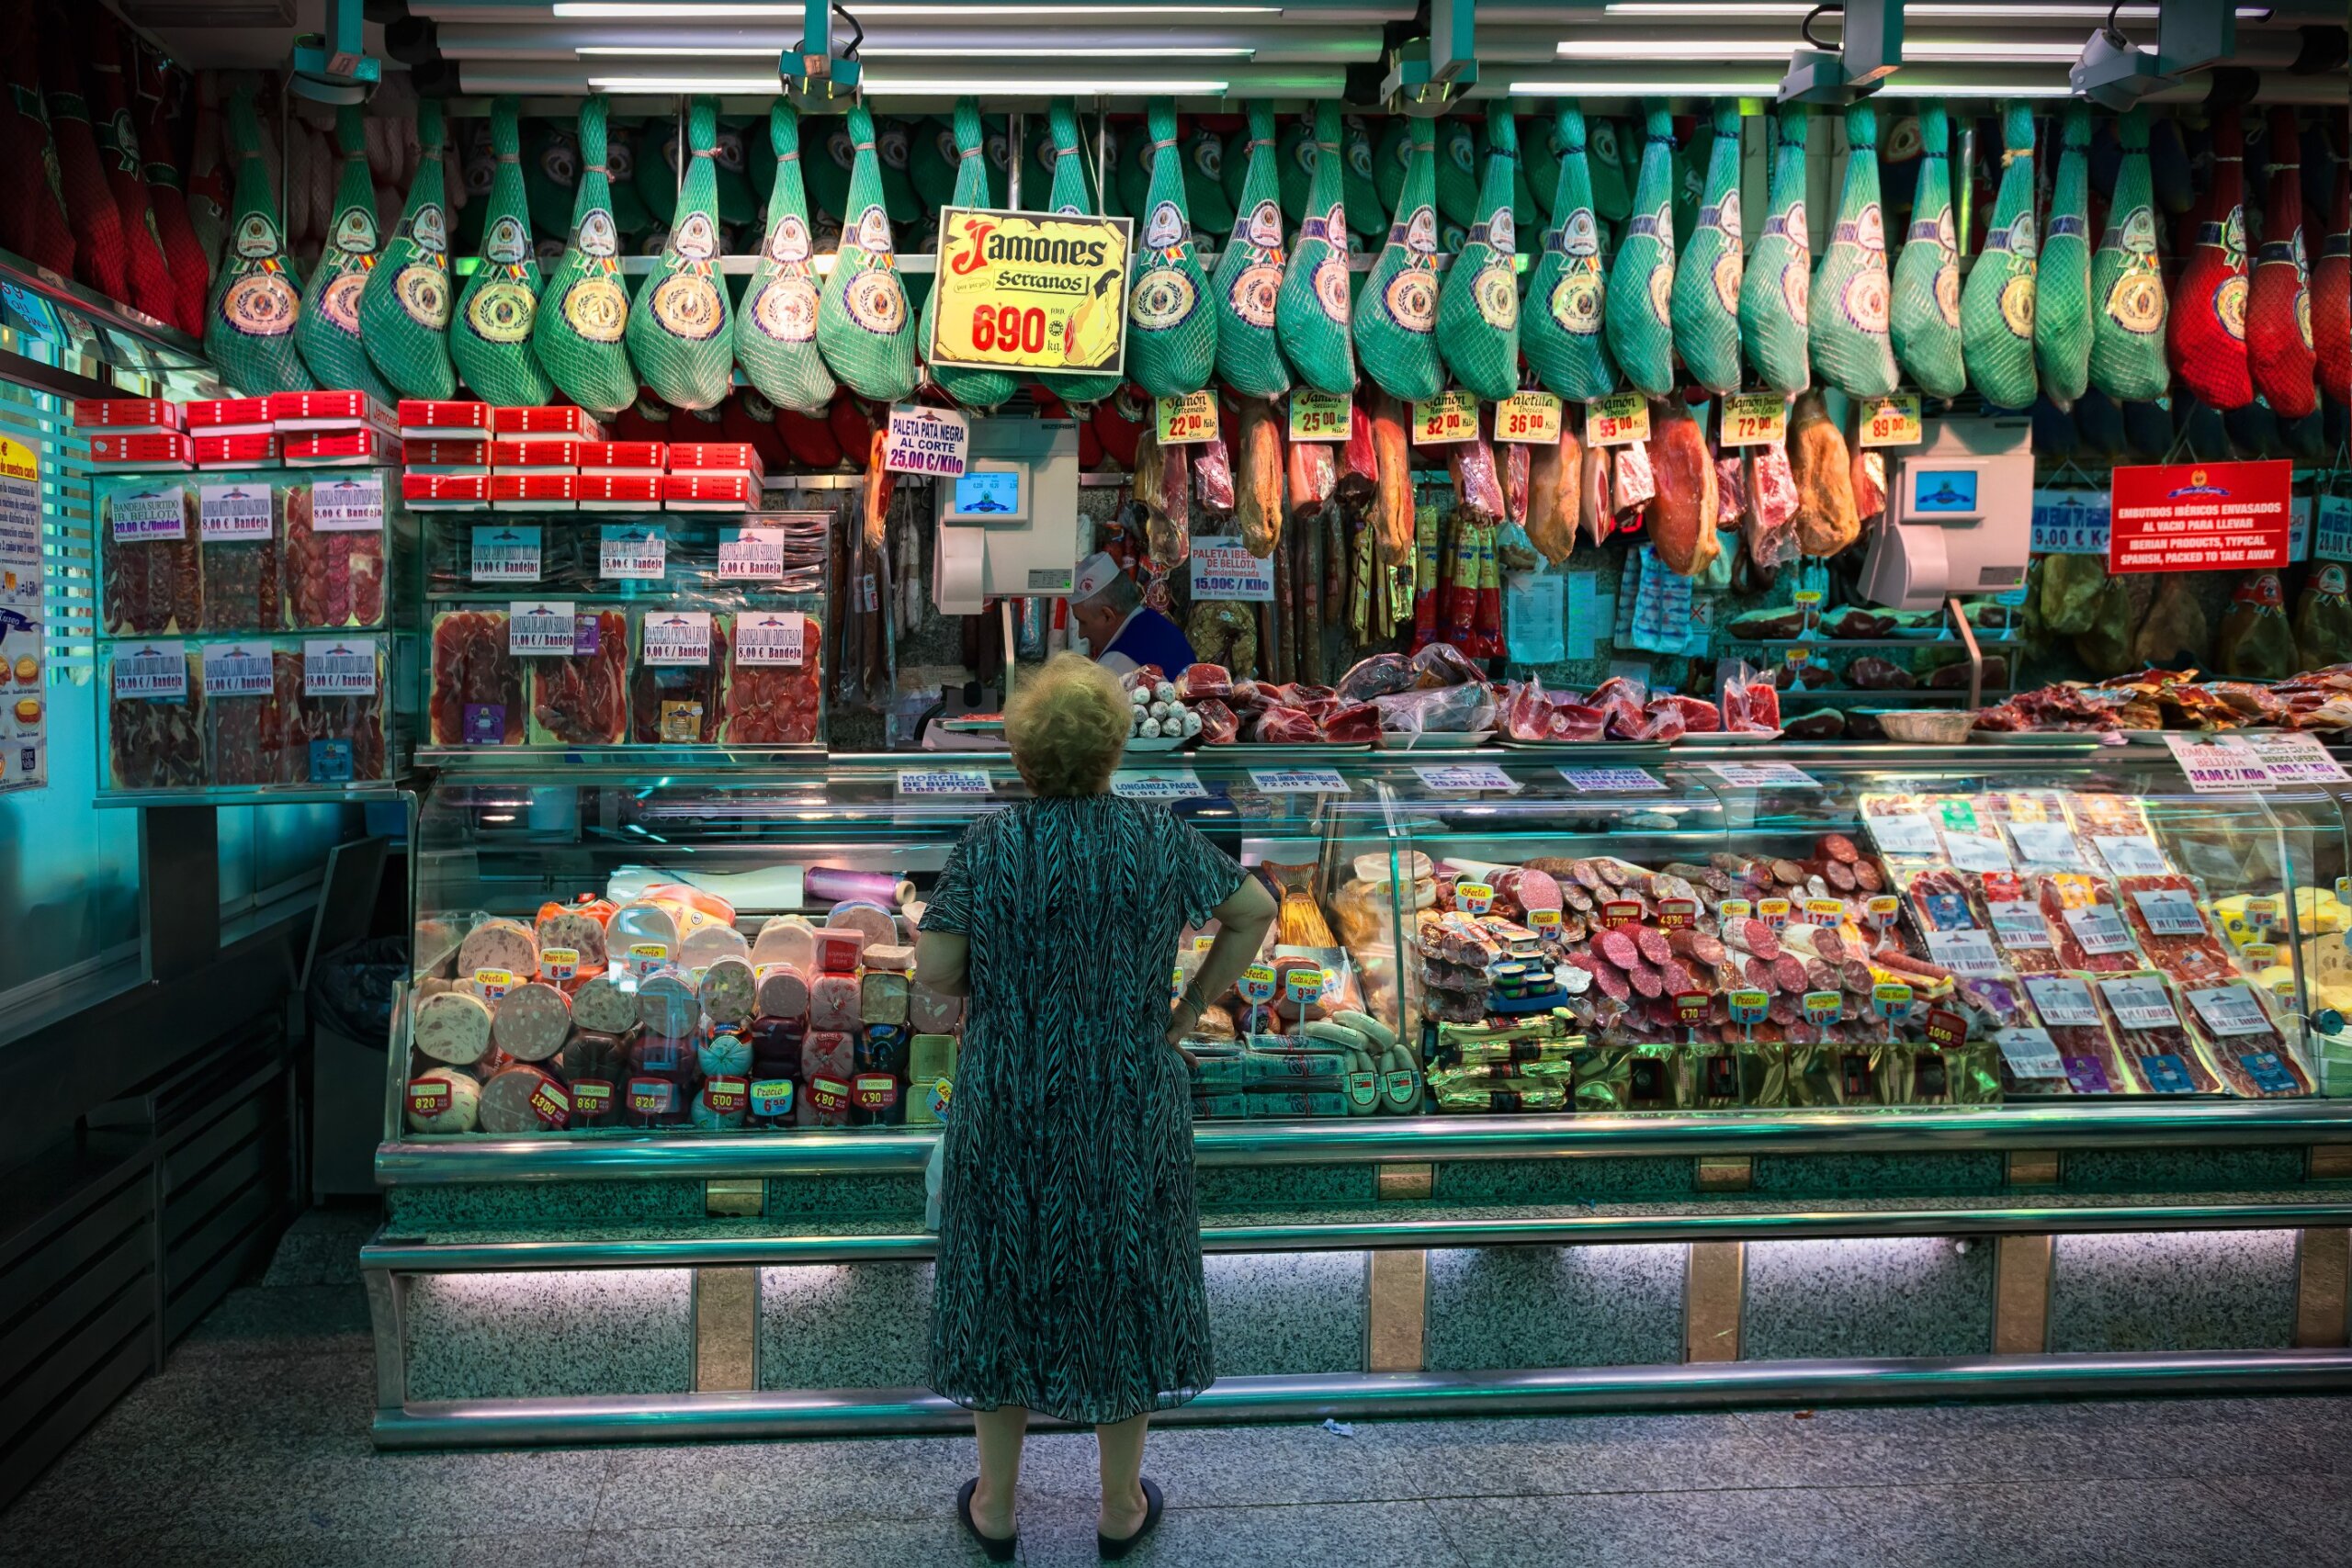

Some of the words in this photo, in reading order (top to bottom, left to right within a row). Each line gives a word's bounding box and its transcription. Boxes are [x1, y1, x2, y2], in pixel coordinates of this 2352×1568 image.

[952, 220, 1107, 275] Jamones
[996, 270, 1082, 291] Serranos
[893, 419, 920, 436] PALETA
[921, 423, 940, 439] PATA
[940, 424, 965, 443] NEGRA
[900, 438, 915, 449] AL
[918, 440, 956, 453] CORTE
[889, 448, 925, 470] 25,00
[926, 455, 964, 475] €/Kilo
[114, 502, 146, 513] BANDEJA
[147, 500, 179, 511] SURTIDO
[314, 509, 334, 519] 8,00
[336, 509, 342, 518] €
[346, 507, 382, 519] Bandeja
[2119, 507, 2172, 519] EMBUTIDOS
[2174, 504, 2220, 517] IBÉRICOS
[2222, 502, 2281, 515] ENVASADOS
[130, 509, 179, 522] BELLOTA
[202, 517, 221, 531] 8,00
[223, 517, 230, 530] €
[234, 516, 269, 532] Bandeja
[2143, 522, 2155, 533] AL
[2156, 521, 2186, 532] VACIO
[2188, 520, 2214, 531] PARA
[2216, 518, 2254, 530] LLEVAR
[2130, 539, 2167, 551] IBERIAN
[2169, 536, 2223, 549] PRODUCTS,
[2225, 536, 2267, 547] TYPICAL
[1193, 549, 1227, 558] PALETA
[2120, 553, 2164, 566] SPANISH,
[2165, 552, 2203, 564] PACKED
[2206, 552, 2220, 562] TO
[2220, 551, 2245, 561] TAKE
[2246, 549, 2277, 560] AWAY
[474, 561, 493, 574] 10,00
[496, 561, 501, 573] €
[504, 561, 538, 574] Bandejas
[603, 558, 622, 570] 15,00
[624, 558, 628, 569] €
[633, 558, 662, 570] Bandeja
[720, 562, 738, 574] 6,00
[741, 562, 745, 574] €
[750, 562, 781, 575] Bandeja
[1206, 558, 1218, 568] DE
[1220, 558, 1256, 568] BELLOTA
[1204, 568, 1260, 578] Semideshuesada
[1246, 579, 1270, 591] Kilo
[511, 635, 529, 647] 11,00
[532, 635, 537, 647] €
[545, 634, 573, 648] Bandeja
[645, 626, 670, 645] BANDEJA
[671, 626, 692, 645] CECINA
[646, 646, 662, 659] 9,00
[664, 646, 670, 657] €
[678, 645, 708, 659] Bandeja
[738, 647, 756, 659] 8,00
[759, 647, 764, 659] €
[768, 647, 802, 660] Bandeja
[153, 675, 183, 688] Bandeja
[241, 676, 272, 690] Bandeja
[307, 675, 326, 688] 18,00
[329, 675, 334, 687] €
[343, 674, 373, 688] Bandeja
[2194, 757, 2247, 768] BELLOTA
[2189, 768, 2224, 783] 38,00
[2241, 768, 2267, 780] Kilo
[1115, 783, 1168, 791] LONGANIZA
[1169, 782, 1199, 790] PAGES
[582, 1087, 609, 1095] CHOPPED
